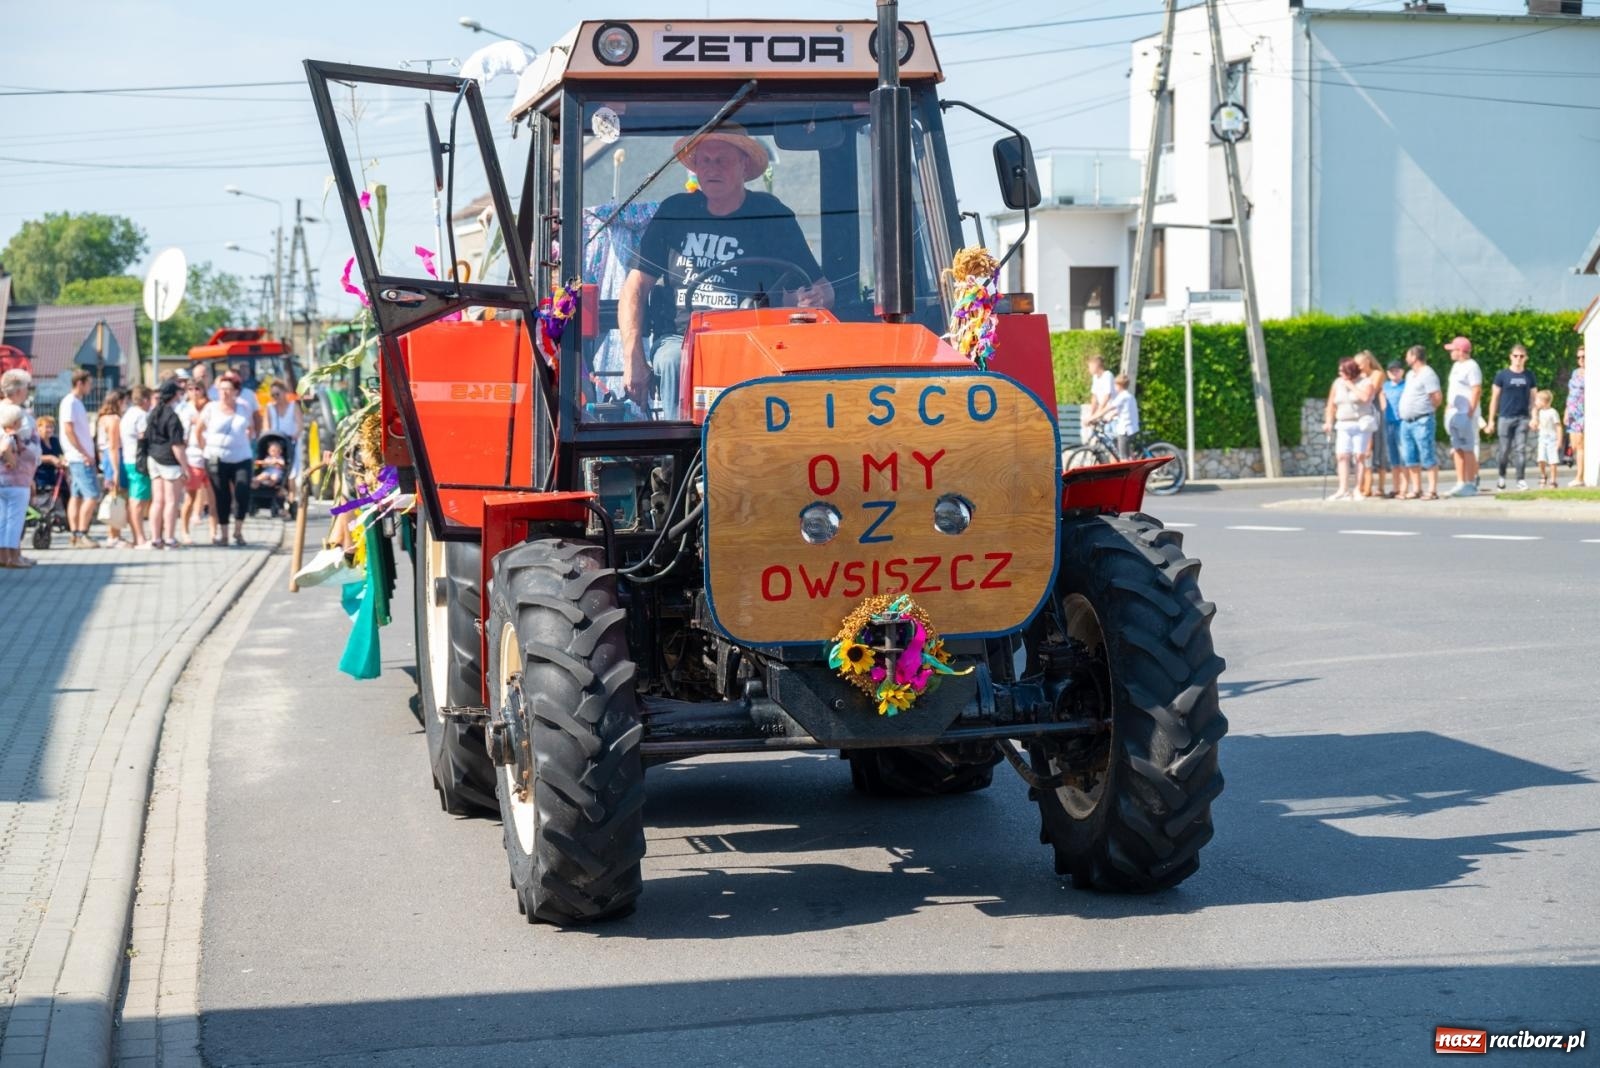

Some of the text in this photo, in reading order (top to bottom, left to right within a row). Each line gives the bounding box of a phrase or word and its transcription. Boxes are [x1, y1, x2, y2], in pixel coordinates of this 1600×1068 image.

[663, 35, 844, 62] ZETOR
[765, 384, 998, 433] DISCO
[808, 449, 946, 496] OMY
[858, 501, 897, 544] Z
[761, 552, 1014, 602] OWSISZCZ
